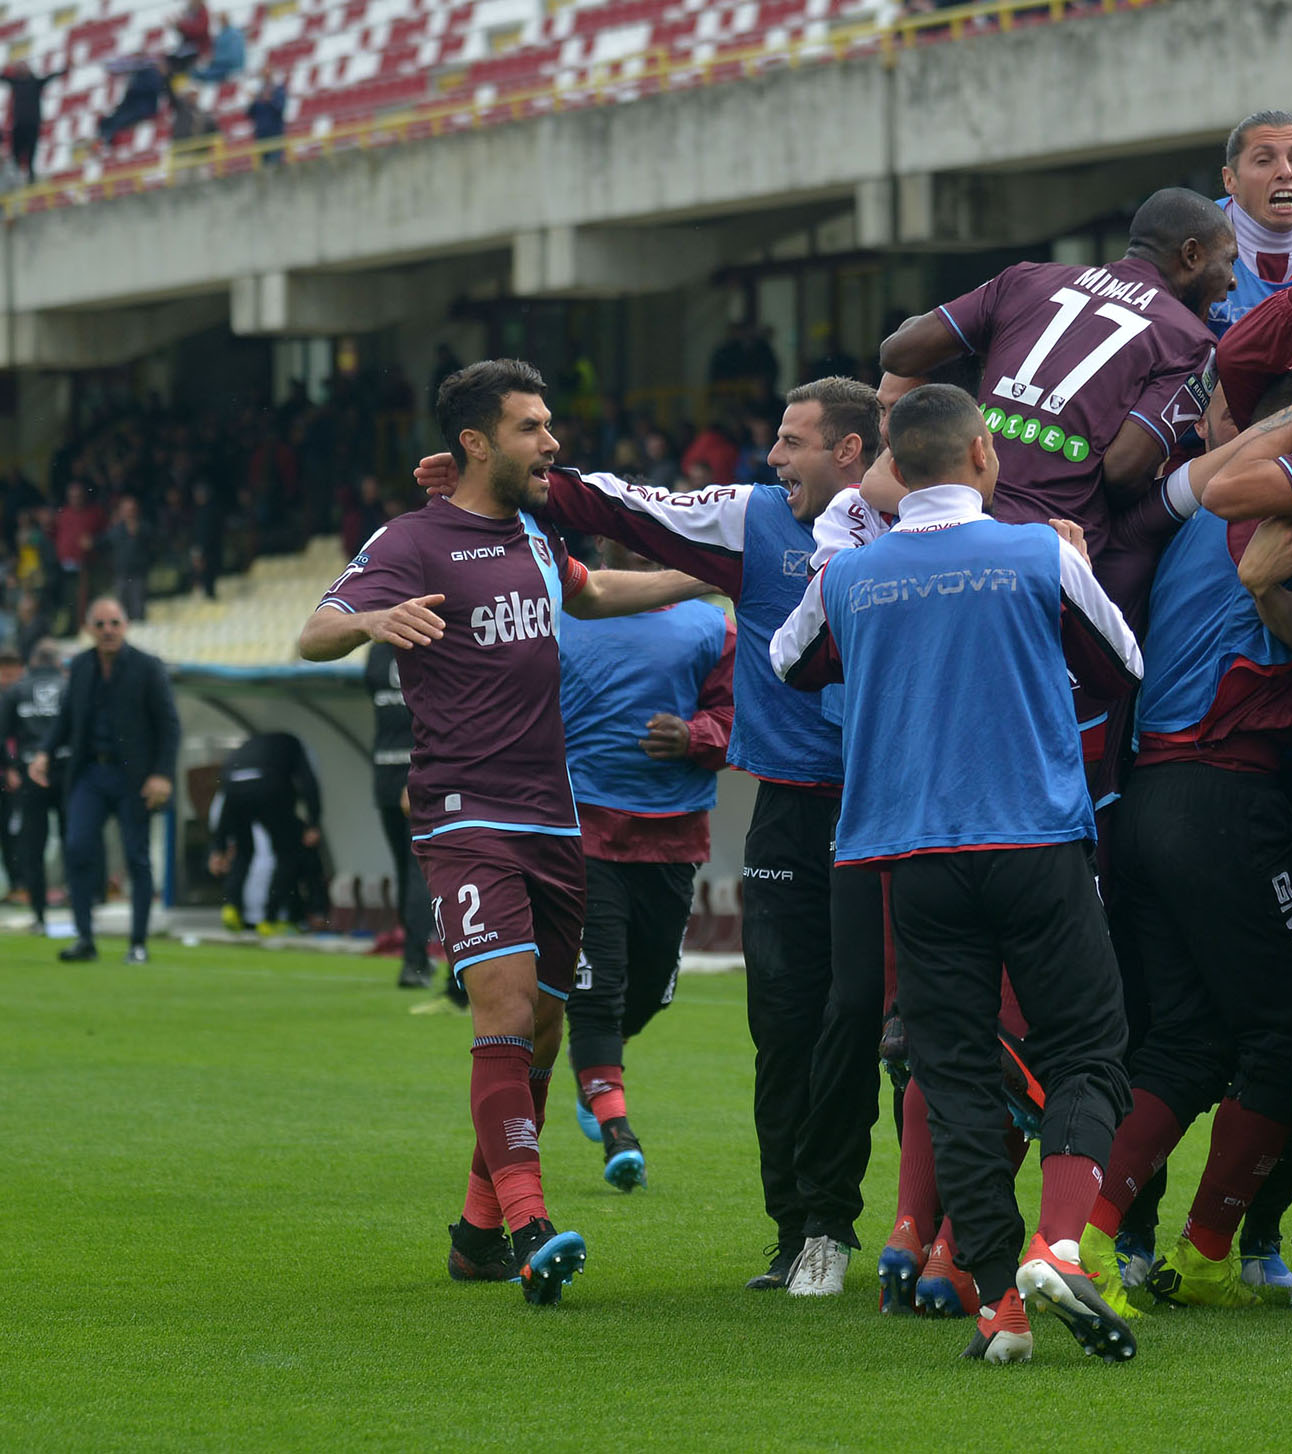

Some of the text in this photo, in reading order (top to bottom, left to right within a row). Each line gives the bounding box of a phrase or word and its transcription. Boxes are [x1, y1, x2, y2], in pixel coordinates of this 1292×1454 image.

[1074, 267, 1159, 311] MINALA
[992, 286, 1153, 415] 17
[981, 408, 1087, 460] NIBET
[451, 546, 506, 561] GIVOVA
[872, 568, 1017, 605] GIVOVA
[457, 883, 485, 936] 2
[453, 931, 498, 952] GIVOVA
